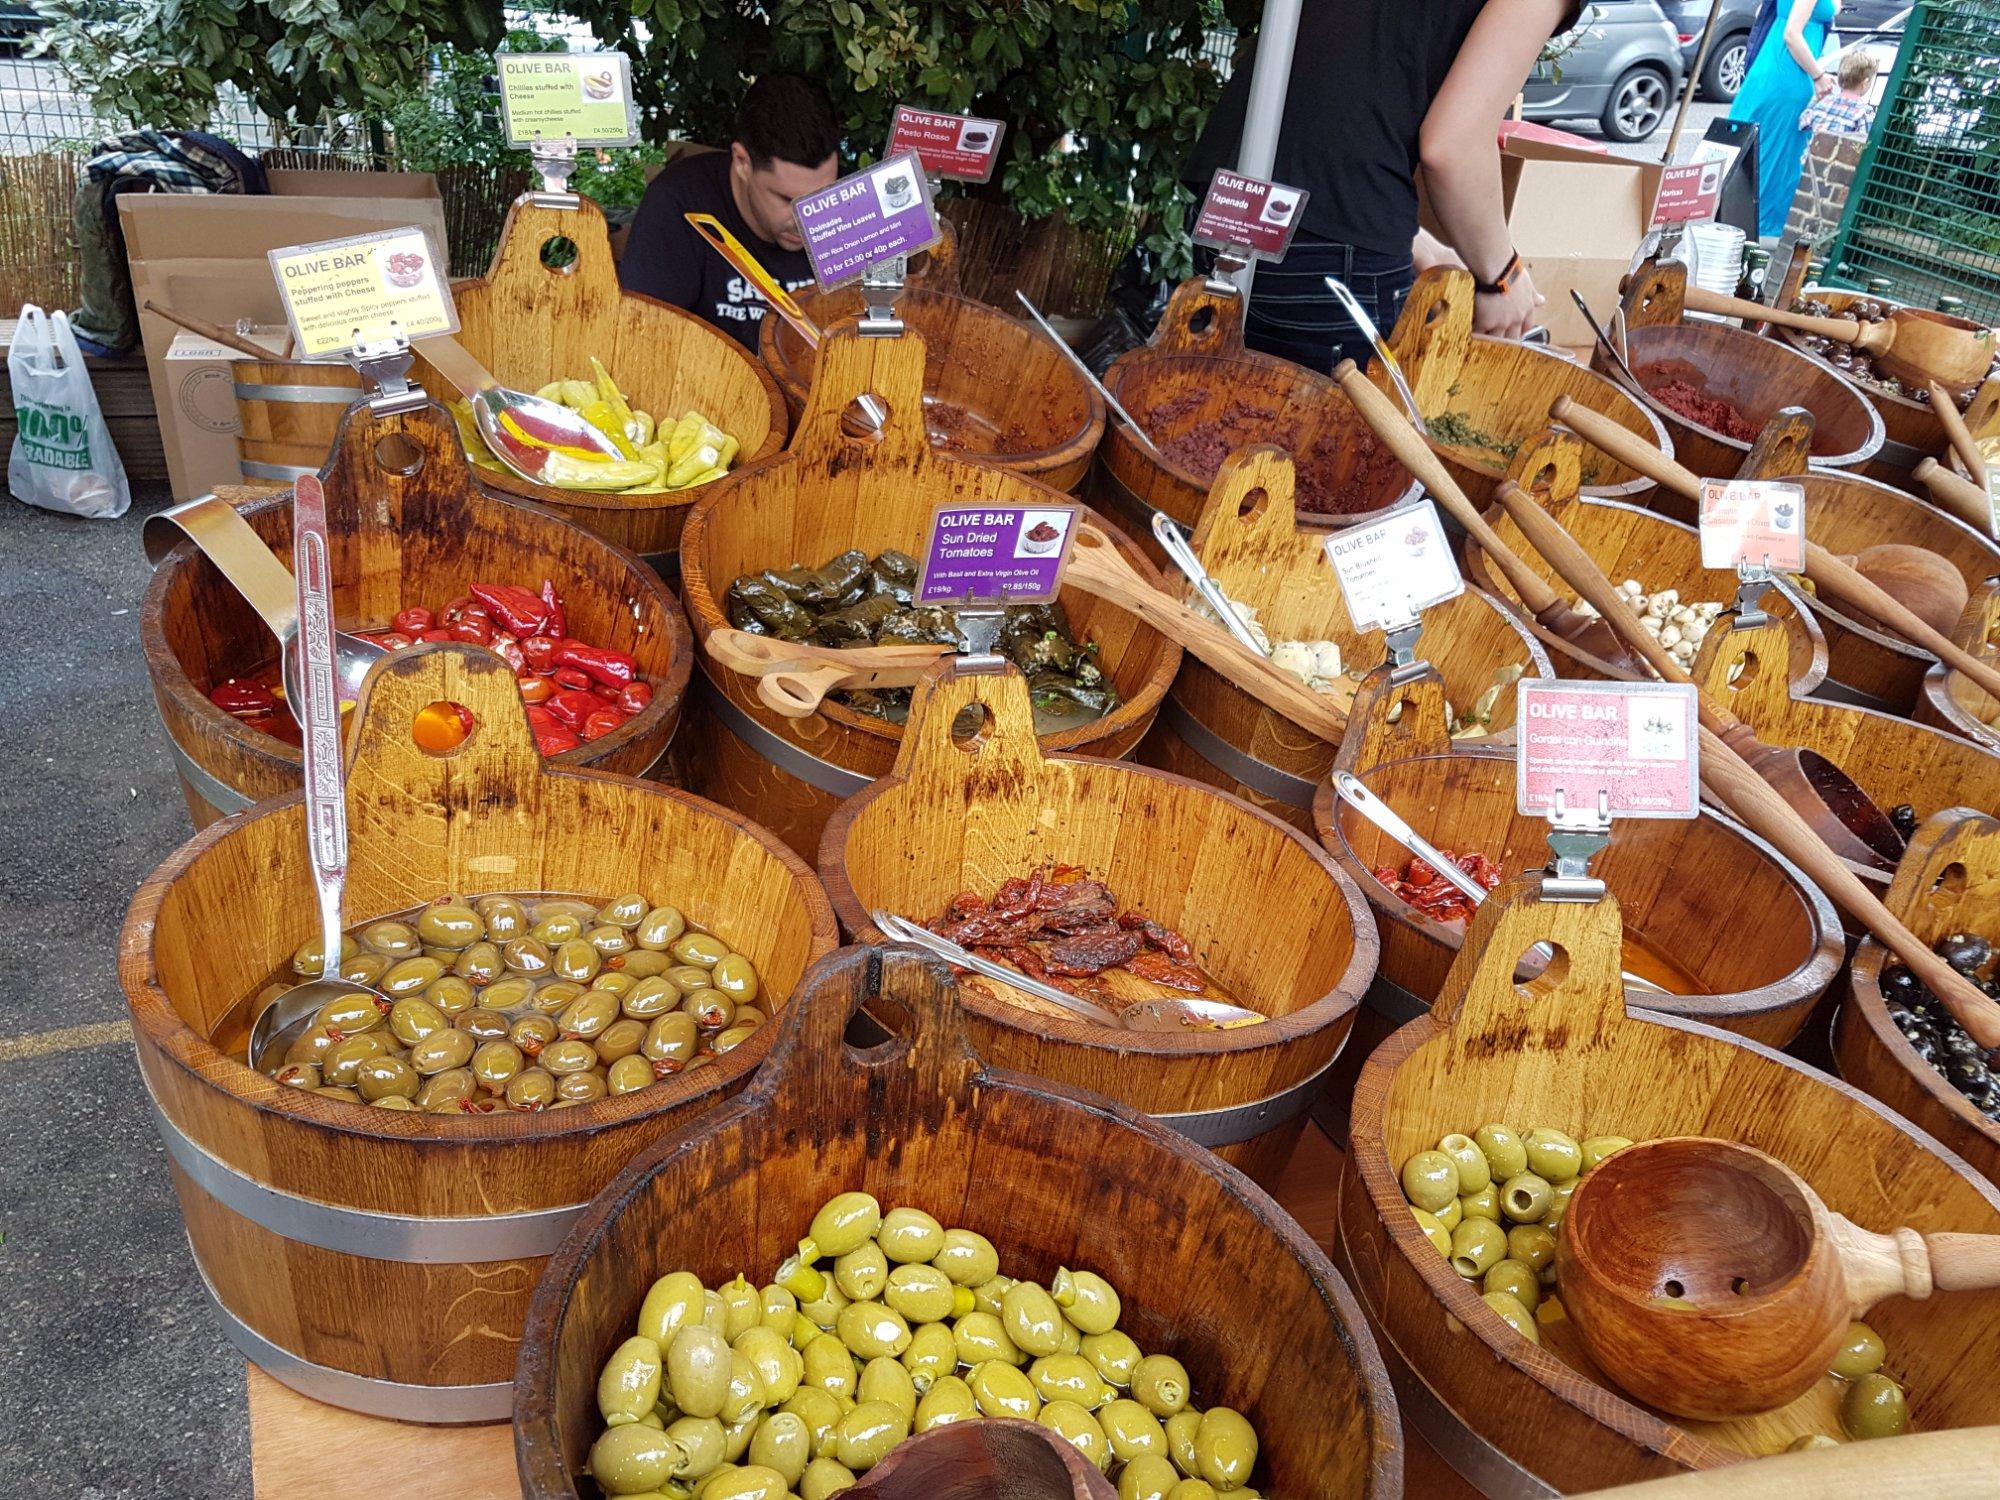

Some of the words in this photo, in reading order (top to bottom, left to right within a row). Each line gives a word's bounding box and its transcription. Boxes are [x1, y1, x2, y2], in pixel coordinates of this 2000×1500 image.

[506, 63, 542, 74] OLIVE
[546, 62, 571, 73] BAR
[901, 114, 933, 126] OLIVE
[934, 118, 956, 129] BAR
[898, 128, 922, 138] Pesto
[924, 132, 950, 142] Rosso
[1666, 170, 1685, 180] OLIVE
[1686, 168, 1700, 178] BAR
[1218, 176, 1244, 191] OLIVE
[1246, 182, 1266, 196] BAR
[802, 194, 839, 217] OLIVE
[840, 182, 868, 201] BAR
[1212, 192, 1248, 210] Tapenade
[808, 216, 842, 235] Dolmades
[812, 229, 836, 243] Stuffed
[838, 224, 852, 232] Vine
[853, 212, 876, 226] Leaves
[818, 251, 831, 261] With
[831, 246, 844, 256] Rice
[844, 240, 860, 250] Onion
[860, 232, 878, 242] Lemon
[879, 226, 890, 234] and
[890, 220, 902, 230] Mint
[824, 266, 833, 276] 10
[834, 262, 844, 272] for
[844, 254, 864, 268] £3.00
[866, 250, 872, 258] or
[874, 244, 888, 256] 40p
[888, 236, 908, 248] each.
[284, 260, 330, 278] OLIVE
[333, 253, 366, 270] BAR
[291, 282, 334, 298] Peppering
[336, 276, 370, 291] peppers
[294, 293, 324, 306] stuffed
[326, 291, 343, 302] with
[345, 286, 376, 298] Cheese
[300, 314, 321, 324] Sweet
[336, 306, 360, 316] slightly
[361, 304, 379, 314] Spicy
[716, 303, 747, 321] THE
[940, 514, 982, 528] OLIVE
[984, 514, 1014, 526] BAR
[942, 534, 964, 544] Sun
[966, 532, 998, 543] Dried
[1334, 538, 1365, 556] OLIVE
[940, 548, 994, 560] Tomatoes
[996, 570, 1012, 578] Virgin
[1030, 568, 1040, 576] Oil
[1529, 704, 1577, 719] OLIVE
[1582, 705, 1618, 720] BAR
